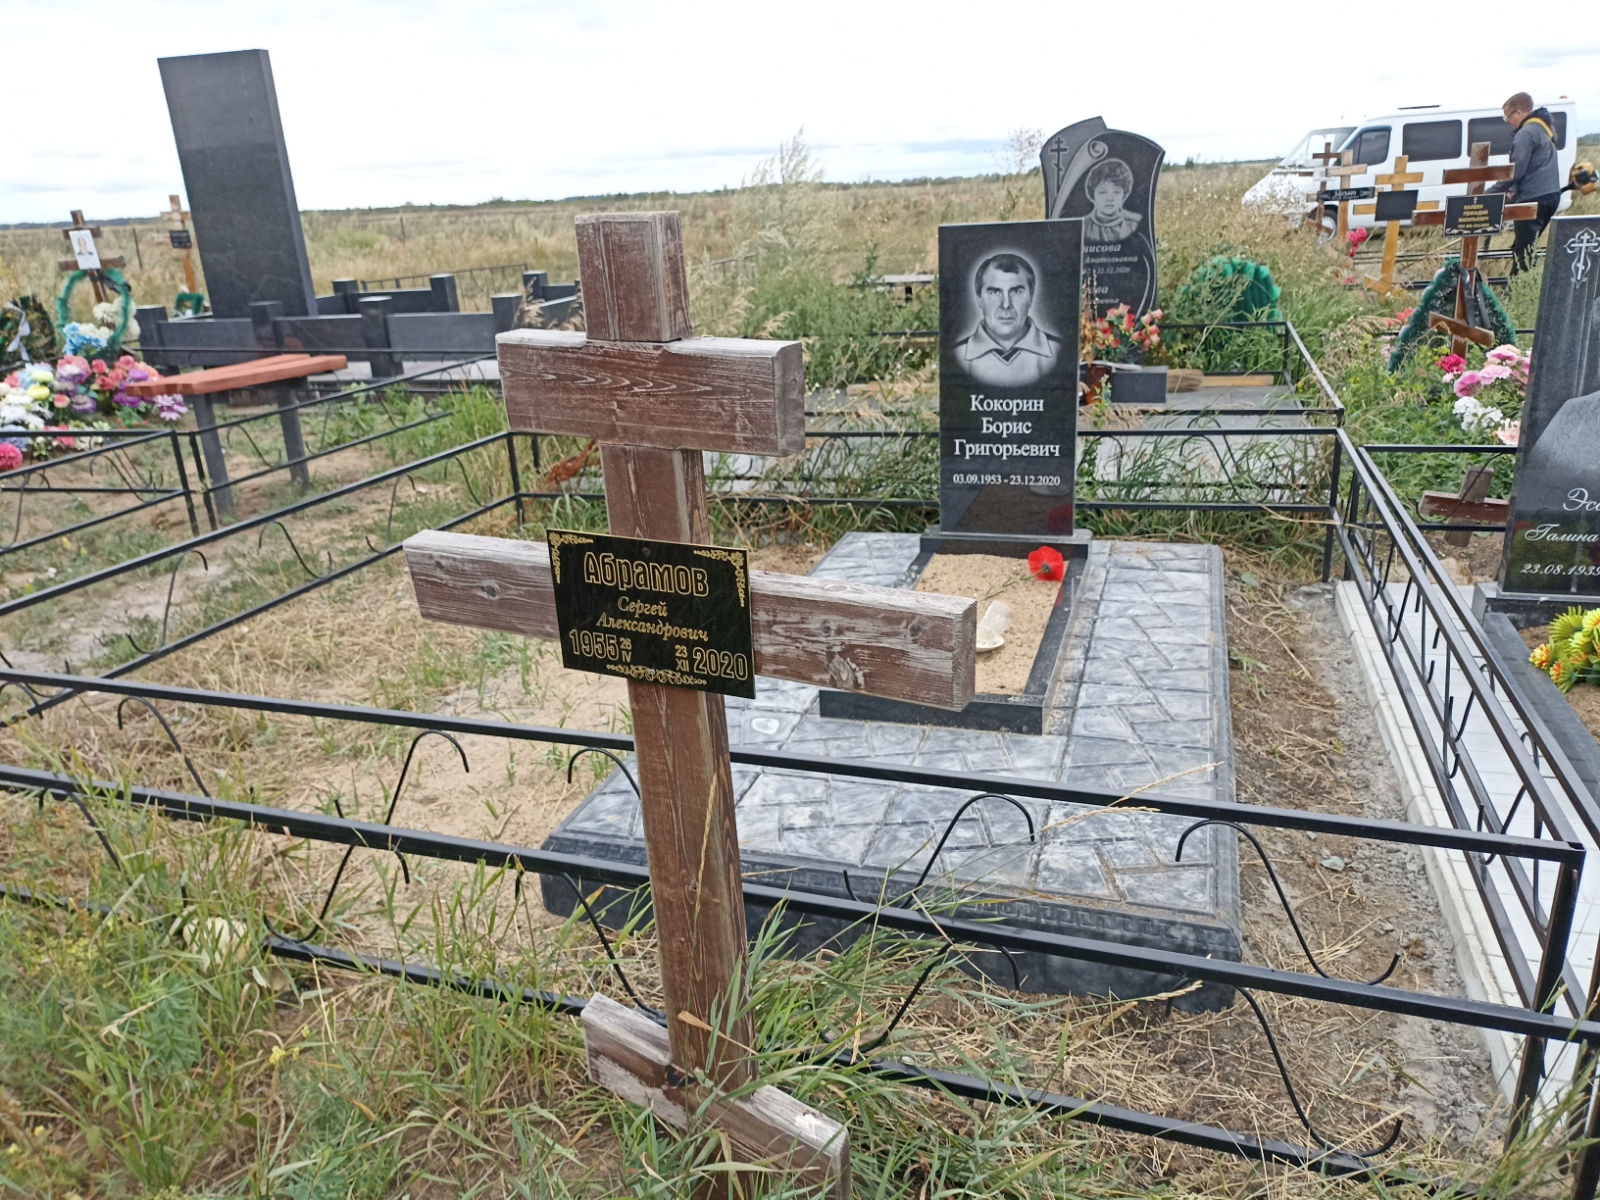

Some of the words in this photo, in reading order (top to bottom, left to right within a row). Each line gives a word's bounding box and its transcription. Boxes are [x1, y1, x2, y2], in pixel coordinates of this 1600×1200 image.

[970, 394, 1044, 416] Кокорин
[981, 417, 1032, 438] Борис
[954, 439, 1060, 460] Григорьевич
[953, 473, 1002, 485] 03.09.1953
[1009, 475, 1061, 486] 23.12.2020
[1525, 523, 1599, 543] Галина
[584, 551, 710, 597] Абрамов
[617, 595, 668, 618] Сергей
[596, 612, 709, 642] Александрович
[569, 629, 619, 660] 1955
[675, 644, 688, 658] 23
[622, 651, 632, 663] IV
[676, 658, 690, 672] XII
[693, 646, 749, 682] 2020
